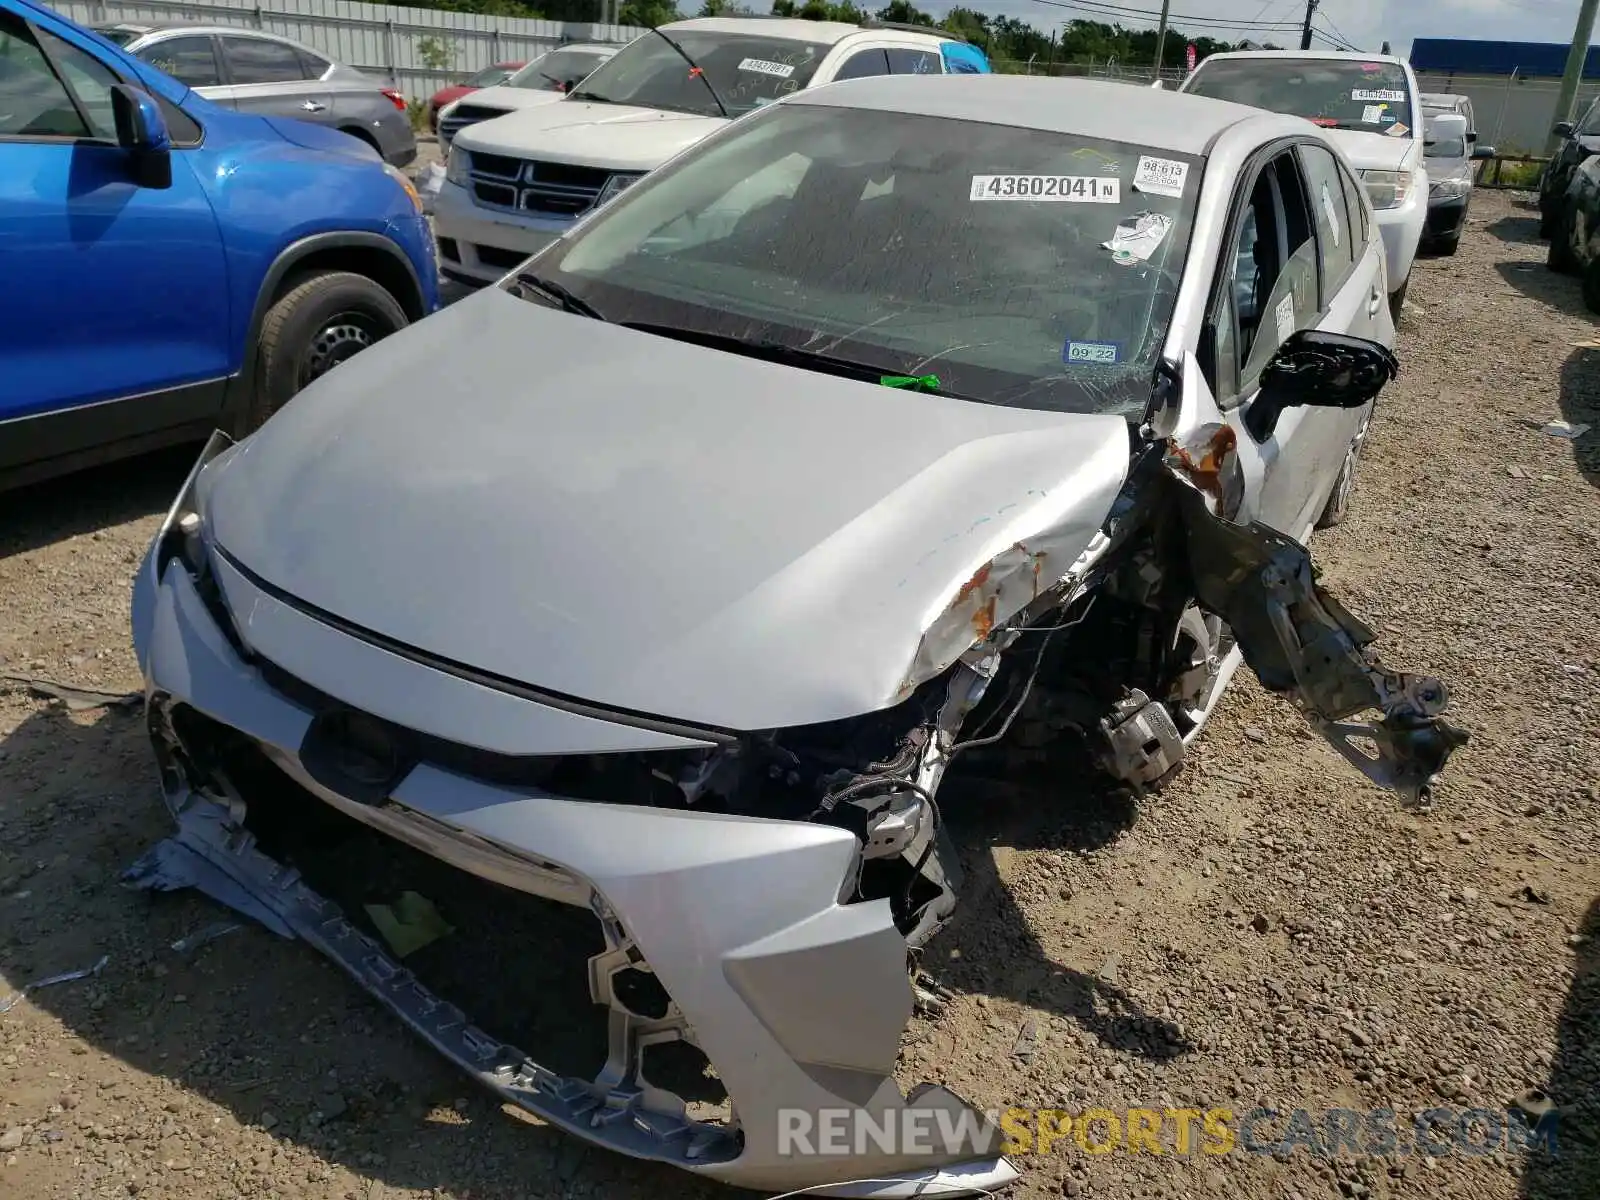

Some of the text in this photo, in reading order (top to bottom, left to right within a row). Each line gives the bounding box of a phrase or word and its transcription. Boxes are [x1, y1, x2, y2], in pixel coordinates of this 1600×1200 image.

[988, 177, 1097, 197] 43602041
[1103, 185, 1113, 196] N
[1072, 348, 1113, 359] 09 22
